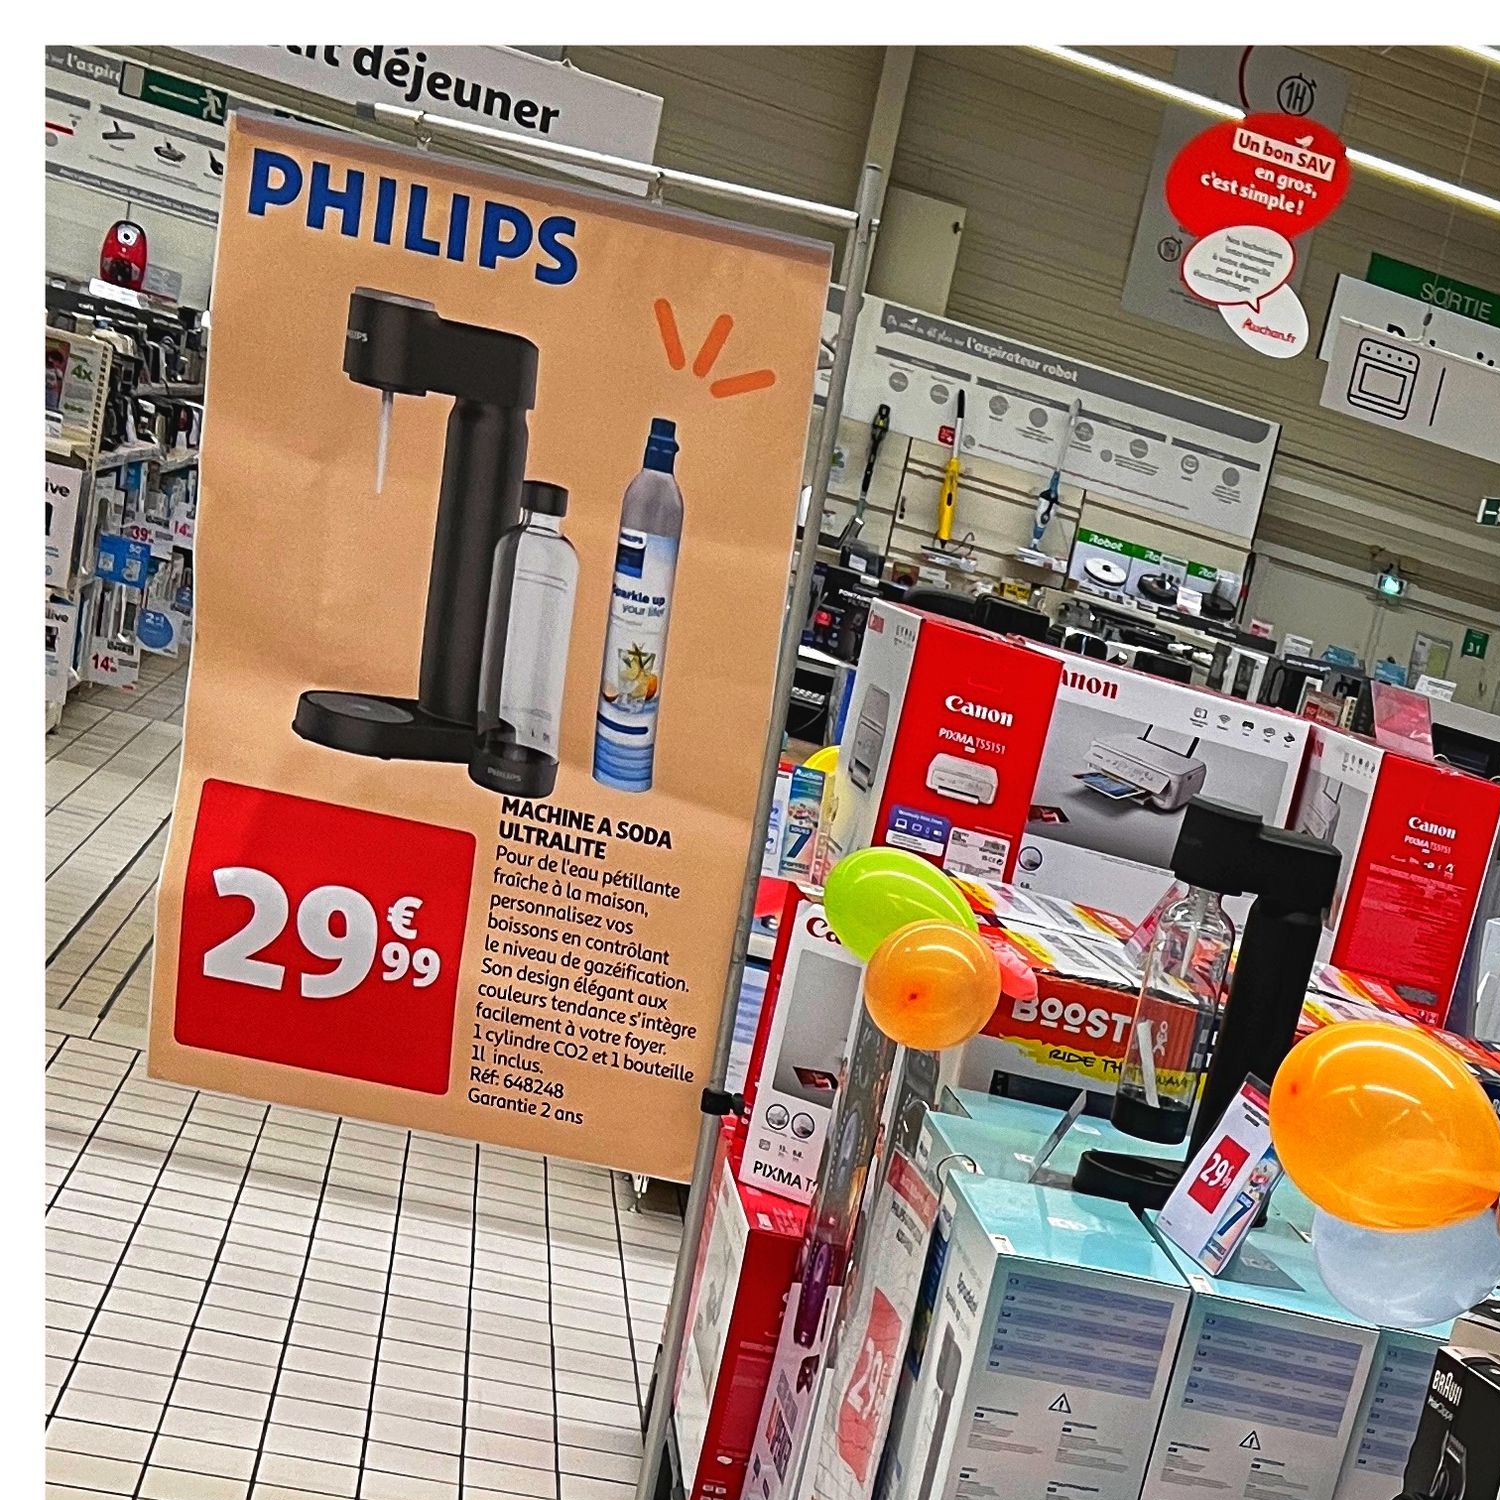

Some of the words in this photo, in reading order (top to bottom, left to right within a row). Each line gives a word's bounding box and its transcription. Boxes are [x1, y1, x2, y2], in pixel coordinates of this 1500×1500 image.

[353, 46, 560, 133] déjeuner
[1239, 132, 1261, 152] Un
[1264, 139, 1294, 163] bon
[1298, 149, 1331, 174] SAV
[1201, 171, 1239, 195] c'est
[1240, 182, 1296, 213] simple
[1254, 166, 1275, 182] en
[1277, 172, 1317, 198] gros,
[248, 148, 578, 285] PHILIPS
[1420, 281, 1493, 322] SORTIE
[1242, 318, 1296, 344] Auchan.fr
[966, 336, 1041, 369] l'aspirateur
[1042, 363, 1078, 382] robot
[945, 694, 1013, 728] Canon
[938, 727, 975, 747] PIXMA
[499, 820, 607, 859] ULTRALITE
[502, 796, 595, 833] MACHINE
[597, 818, 612, 837] A
[616, 821, 672, 850] SODA
[1408, 816, 1457, 840] Canon
[493, 867, 549, 894] fraîche
[586, 891, 649, 918] maison,
[496, 845, 534, 867] Pour
[538, 854, 558, 873] de
[561, 859, 598, 881] l'eau
[602, 870, 681, 899] pétillante
[203, 867, 378, 999] 29
[490, 894, 602, 928] personnalisez
[606, 918, 634, 935] vos
[487, 912, 559, 942] boissons
[562, 931, 581, 947] en
[585, 936, 670, 965] contrôlant
[380, 942, 441, 987] 99
[481, 958, 512, 978] Son
[516, 965, 570, 992] design
[573, 977, 634, 1003] élégant
[637, 994, 668, 1011] aux
[485, 934, 499, 952] le
[503, 940, 557, 964] niveau
[560, 951, 580, 969] de
[584, 959, 690, 993] gazéification.
[475, 1001, 562, 1034] facilement
[579, 1026, 621, 1045] votre
[625, 1032, 667, 1057] foyer.
[478, 982, 547, 1008] couleurs
[551, 995, 626, 1025] tendance
[629, 1012, 697, 1040] s'intègre
[1012, 997, 1132, 1044] BOOST
[485, 1027, 550, 1053] cylindre
[554, 1040, 589, 1061] CO2
[624, 1056, 694, 1083] bouteille
[493, 1049, 544, 1074] inclus.
[1048, 1047, 1096, 1068] RIDE
[468, 1087, 537, 1115] Garantie
[554, 1108, 584, 1125] ans
[503, 1073, 564, 1099] 648248
[753, 1160, 803, 1186] PIXMA
[1200, 1152, 1229, 1187] 29
[1432, 1369, 1463, 1406] BRAUN
